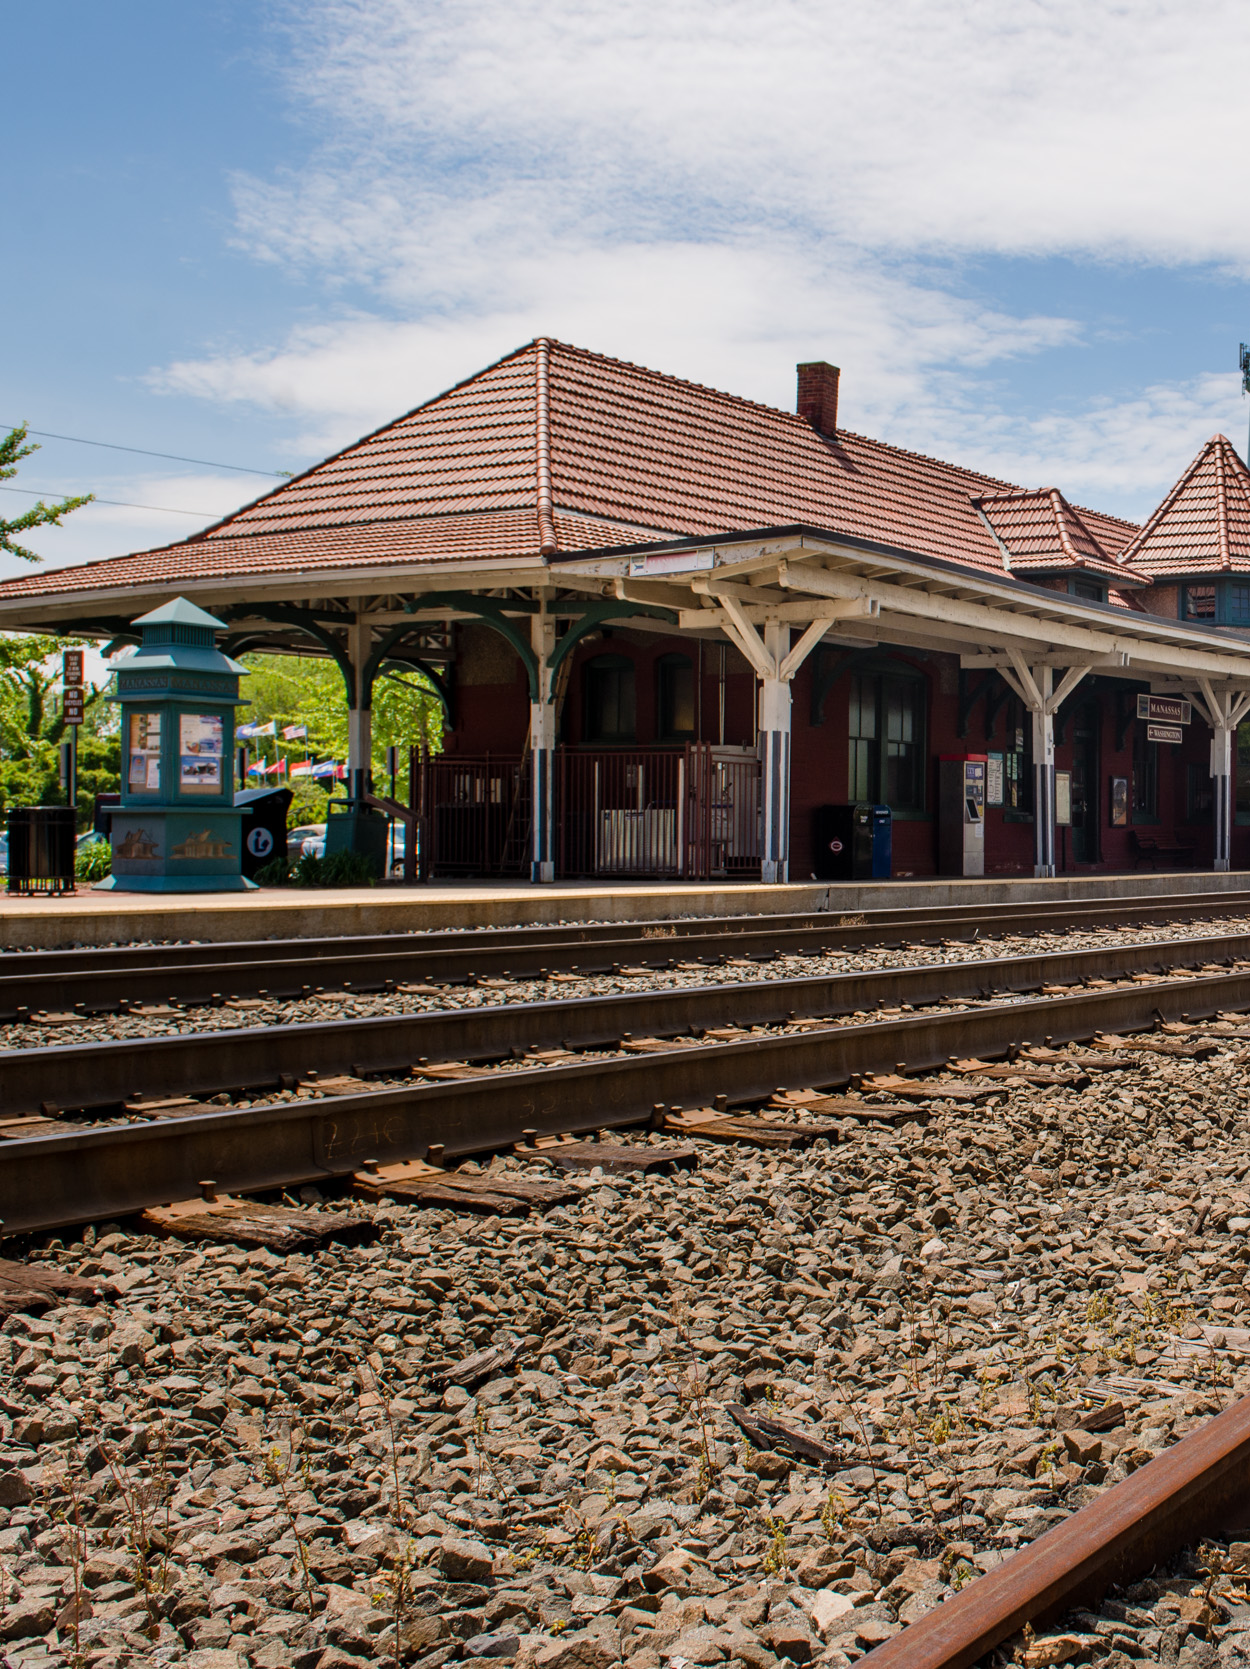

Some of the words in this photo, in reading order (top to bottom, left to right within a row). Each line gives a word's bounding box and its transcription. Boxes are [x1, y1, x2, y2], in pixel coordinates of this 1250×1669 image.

[68, 690, 79, 699] NO
[68, 707, 79, 716] NO
[1151, 704, 1180, 715] MANASSAS
[1154, 730, 1181, 739] WASHINGTON
